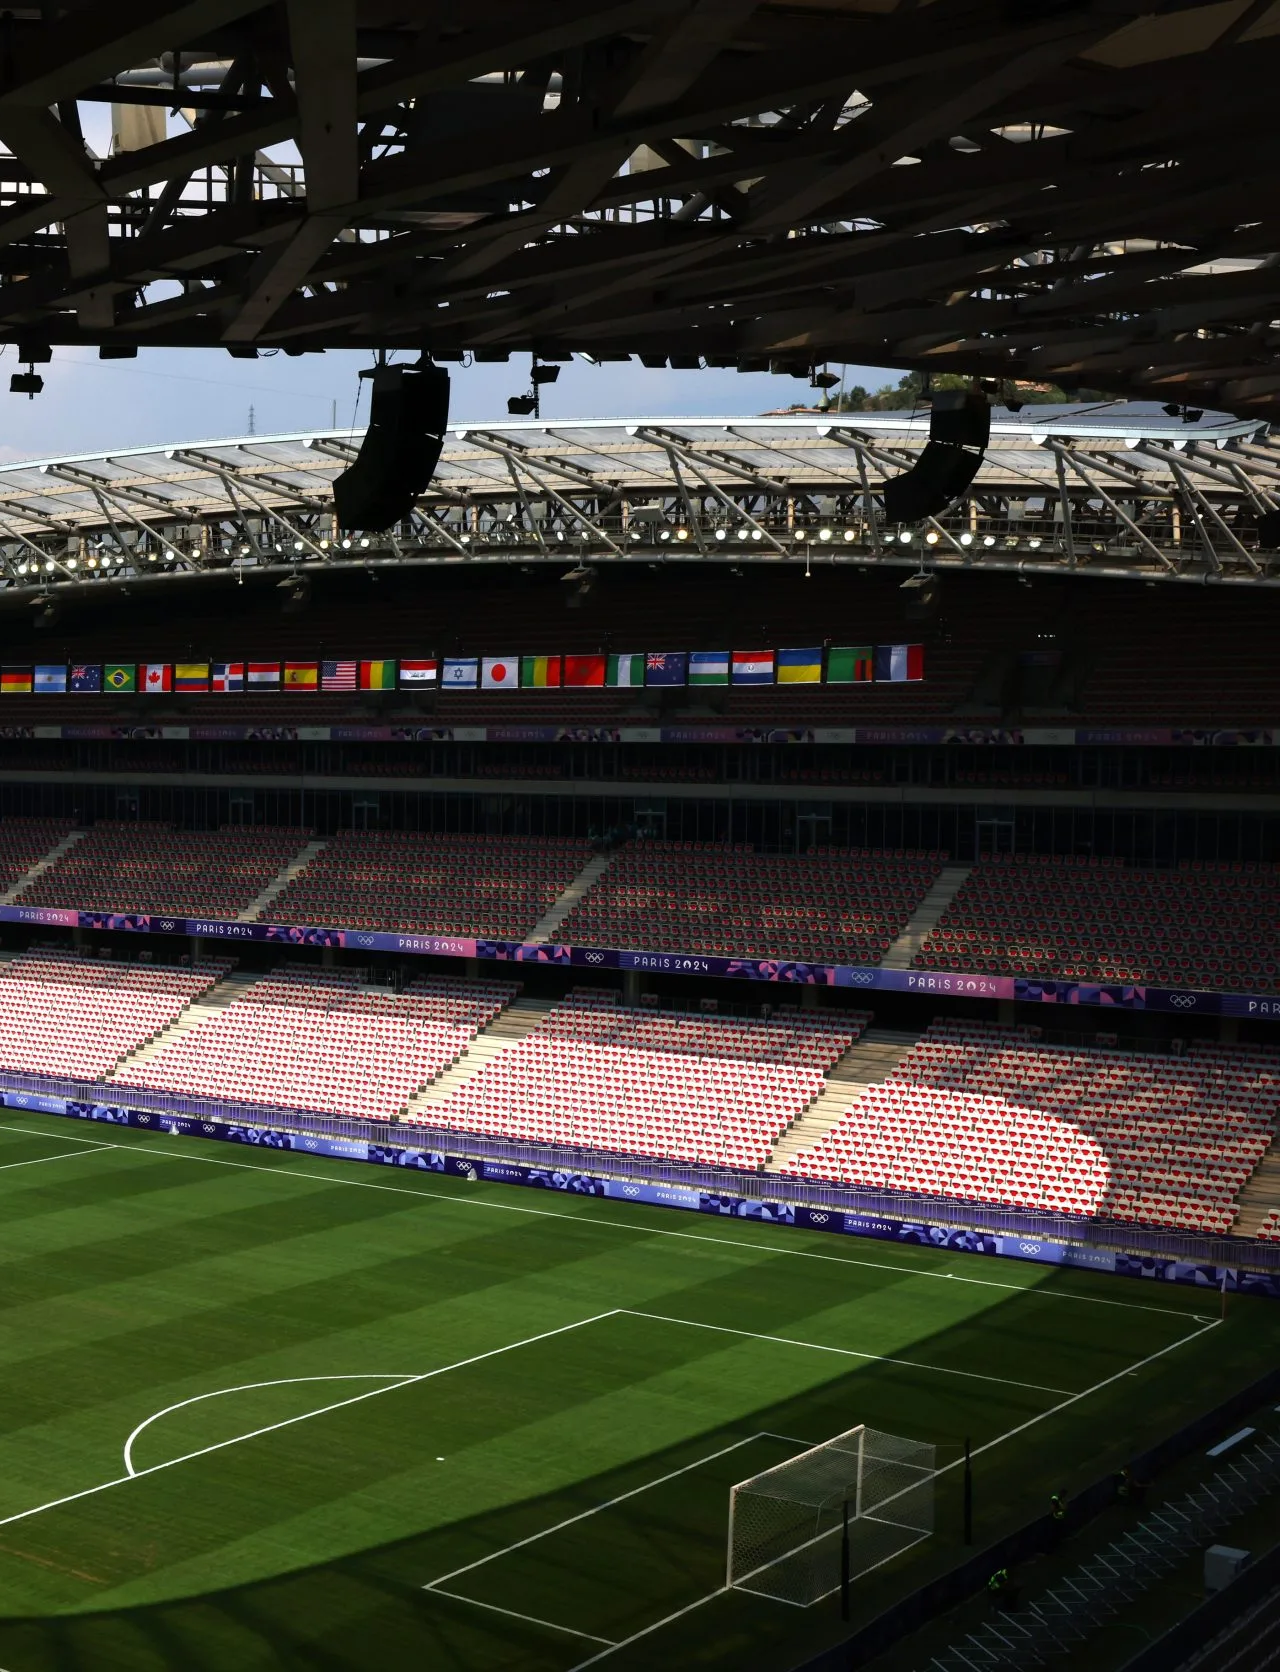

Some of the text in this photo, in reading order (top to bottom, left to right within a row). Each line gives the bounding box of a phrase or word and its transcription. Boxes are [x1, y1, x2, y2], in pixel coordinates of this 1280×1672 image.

[46, 912, 69, 923] 2024
[227, 926, 252, 937] 2024
[434, 941, 464, 953] 2024
[675, 960, 709, 971] 2024
[957, 980, 996, 993] 2024
[1249, 1001, 1280, 1014] PAR
[505, 1168, 522, 1177] 2024
[677, 1194, 696, 1202] 2024
[872, 1222, 892, 1231] 2024
[1087, 1254, 1111, 1264] 2024
